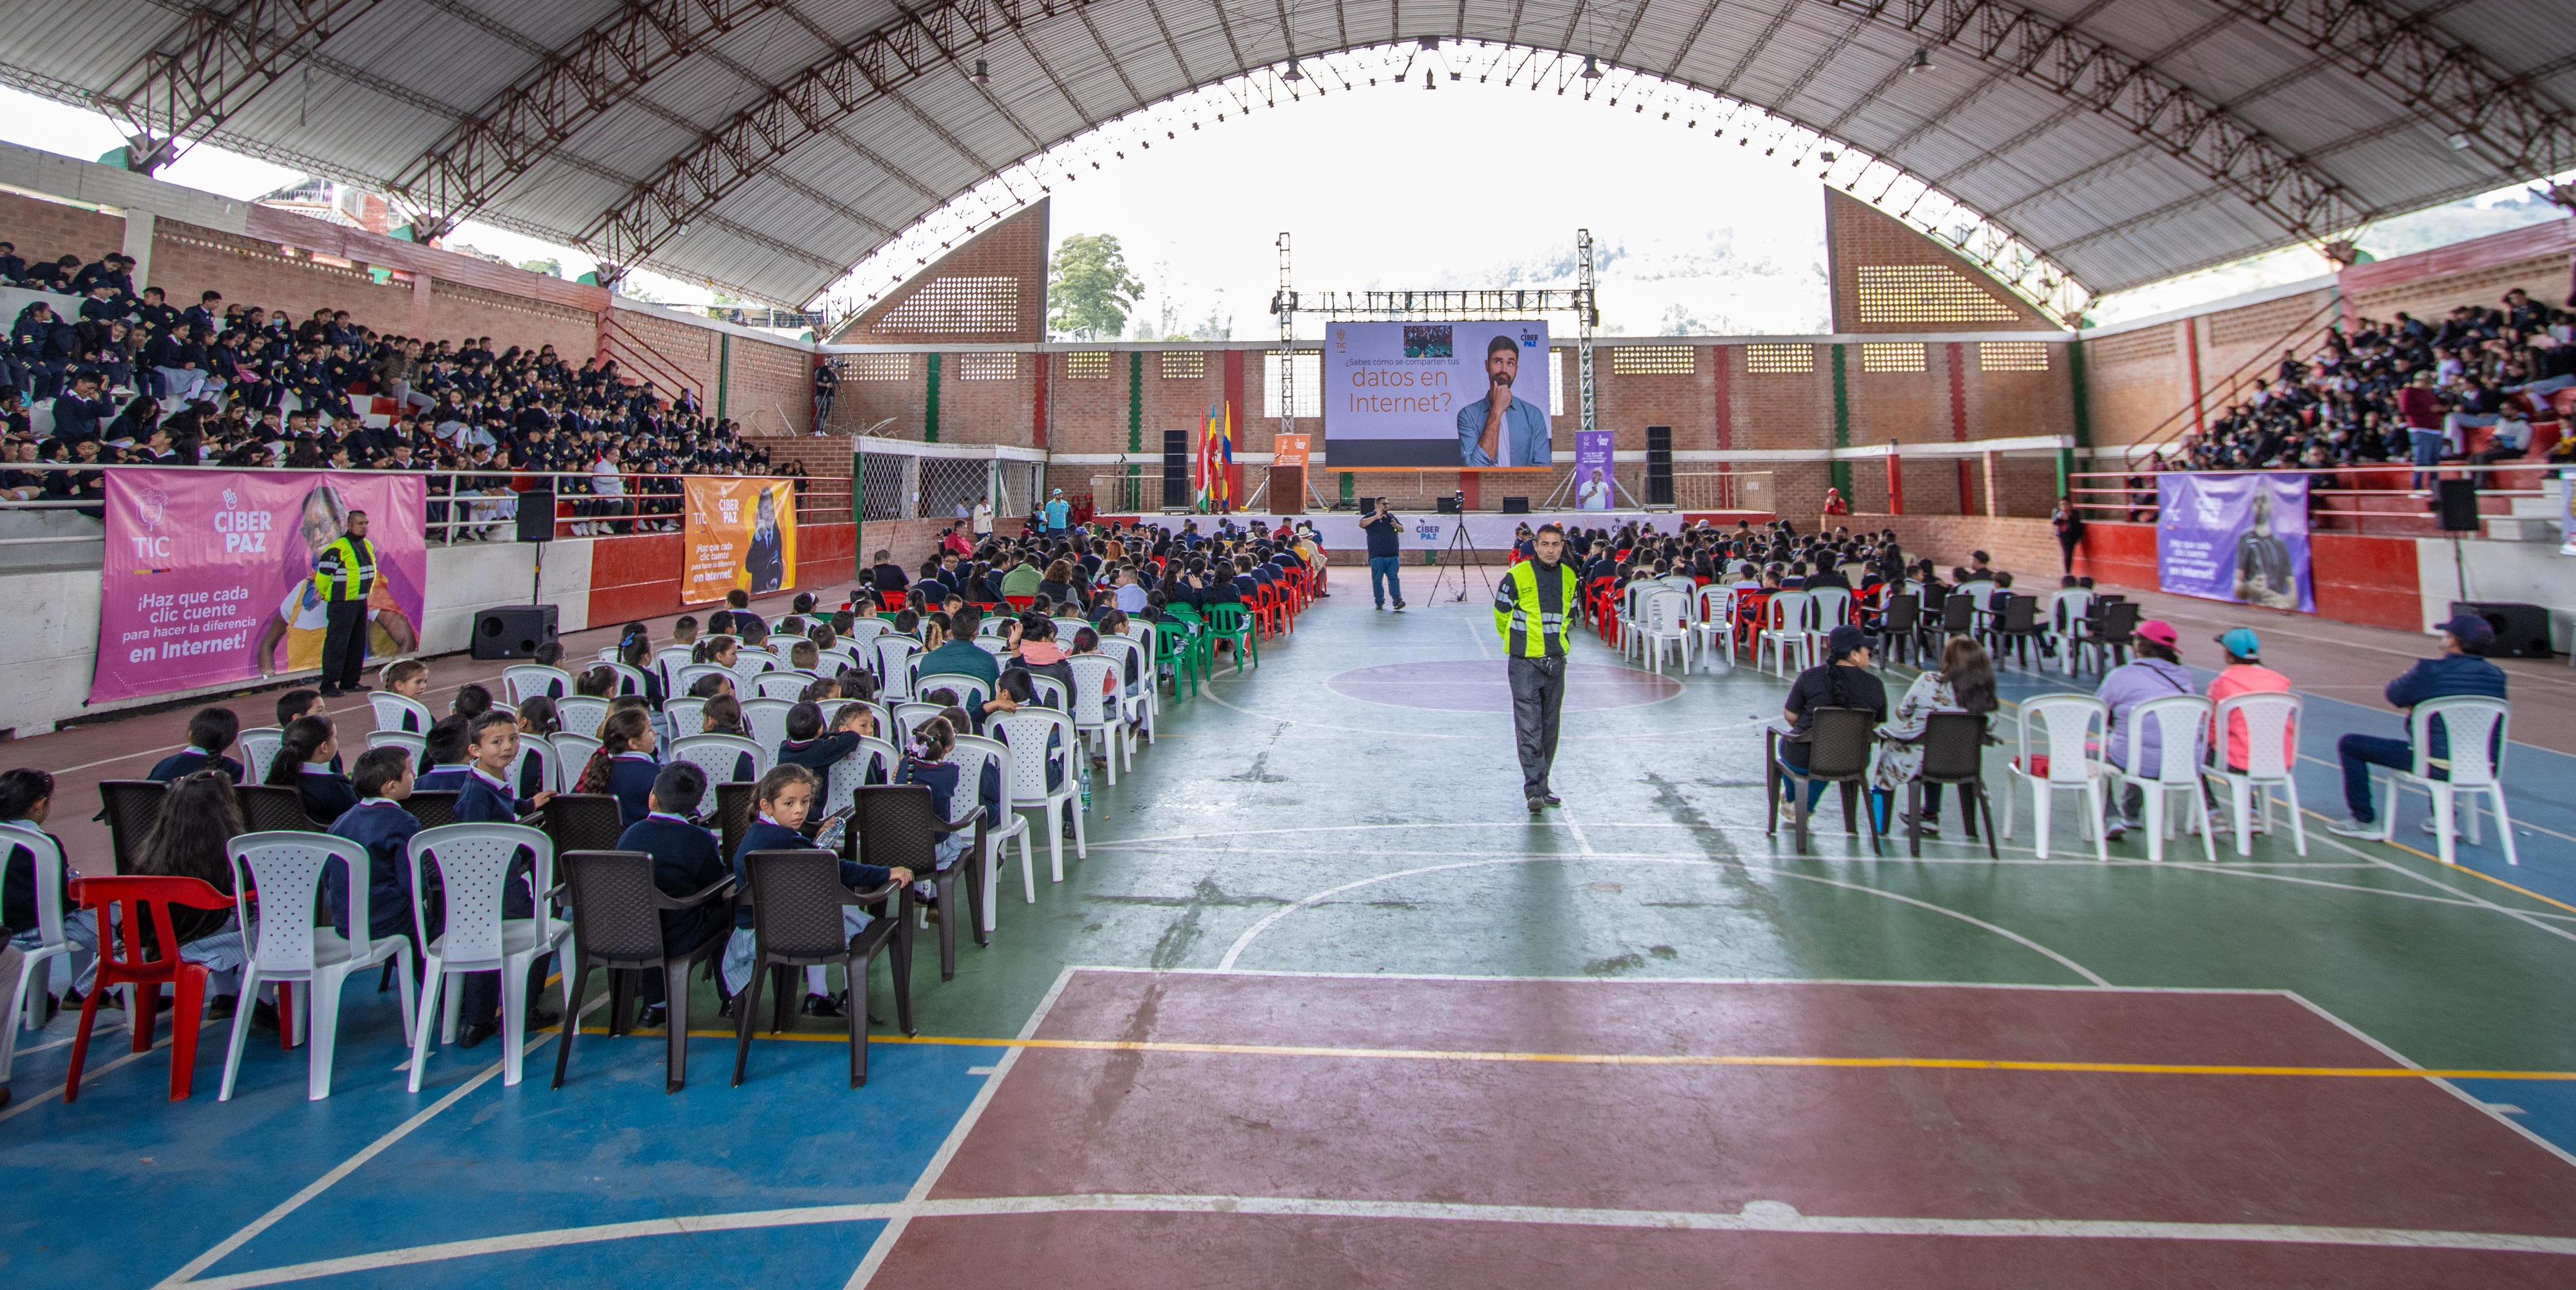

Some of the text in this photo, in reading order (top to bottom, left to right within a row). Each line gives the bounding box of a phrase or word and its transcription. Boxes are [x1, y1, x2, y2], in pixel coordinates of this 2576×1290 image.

[1346, 358, 1371, 367] ¿Sabes
[1405, 358, 1446, 368] comparten
[1352, 366, 1448, 387] datos en
[1350, 392, 1452, 413] Internet?
[719, 499, 739, 511] CIBER
[214, 511, 272, 532] CIBER
[694, 513, 707, 525] TIC
[723, 511, 738, 524] PAZ
[133, 536, 170, 558] TIC
[226, 532, 266, 553] PAZ
[709, 545, 719, 553] que
[721, 542, 733, 550] cada
[711, 552, 729, 560] cuente
[694, 567, 733, 582] en Internet!
[138, 586, 248, 612] ¡Haz que cada
[150, 604, 237, 623] clic cuente
[123, 617, 256, 644] para hacer la diferencia
[129, 629, 247, 663] en Internet!
